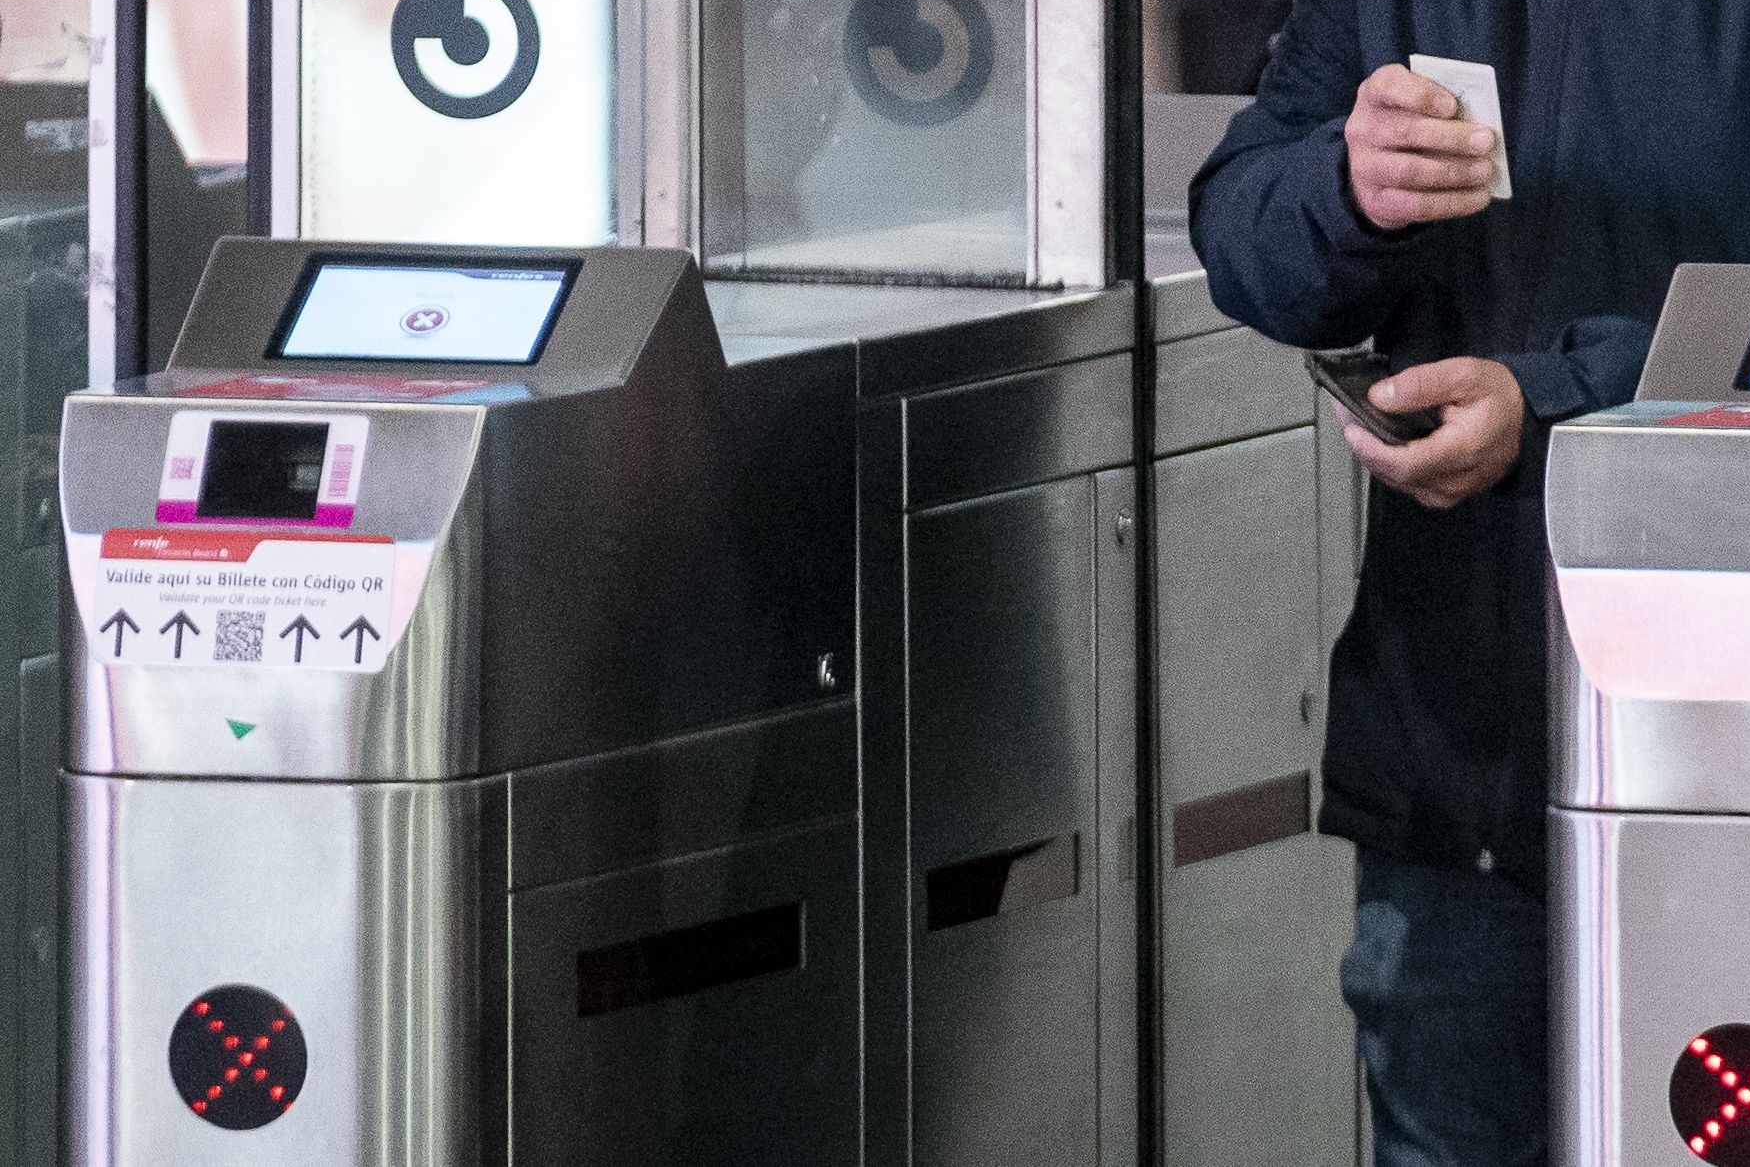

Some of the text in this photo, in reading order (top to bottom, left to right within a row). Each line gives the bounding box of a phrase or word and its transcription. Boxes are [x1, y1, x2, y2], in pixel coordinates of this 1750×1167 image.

[106, 569, 384, 593] Valide aquí su Billete con Código QR
[203, 594, 226, 605] your
[228, 594, 245, 605] QR
